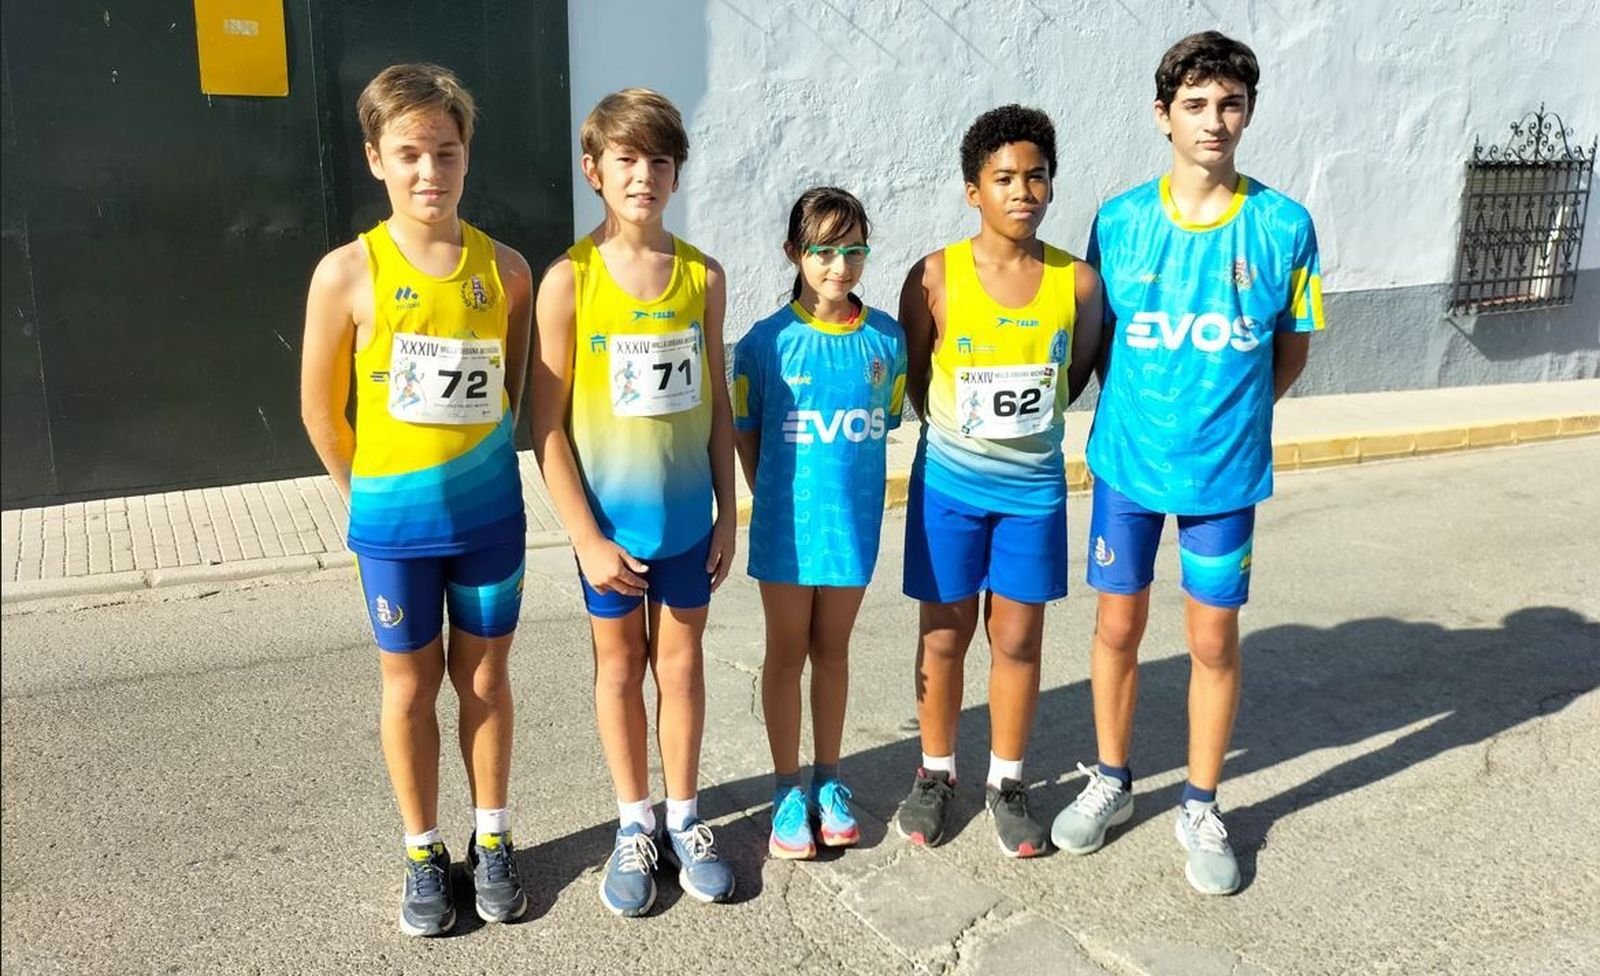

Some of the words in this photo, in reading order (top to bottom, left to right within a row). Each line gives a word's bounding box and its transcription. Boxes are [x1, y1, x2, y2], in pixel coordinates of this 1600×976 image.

[1126, 312, 1260, 352] EVOS
[400, 339, 439, 358] XXXIV
[617, 341, 650, 354] XXXIV
[438, 370, 488, 399] 72
[653, 359, 692, 390] 71
[993, 388, 1041, 417] 62
[782, 407, 885, 444] EVOS
